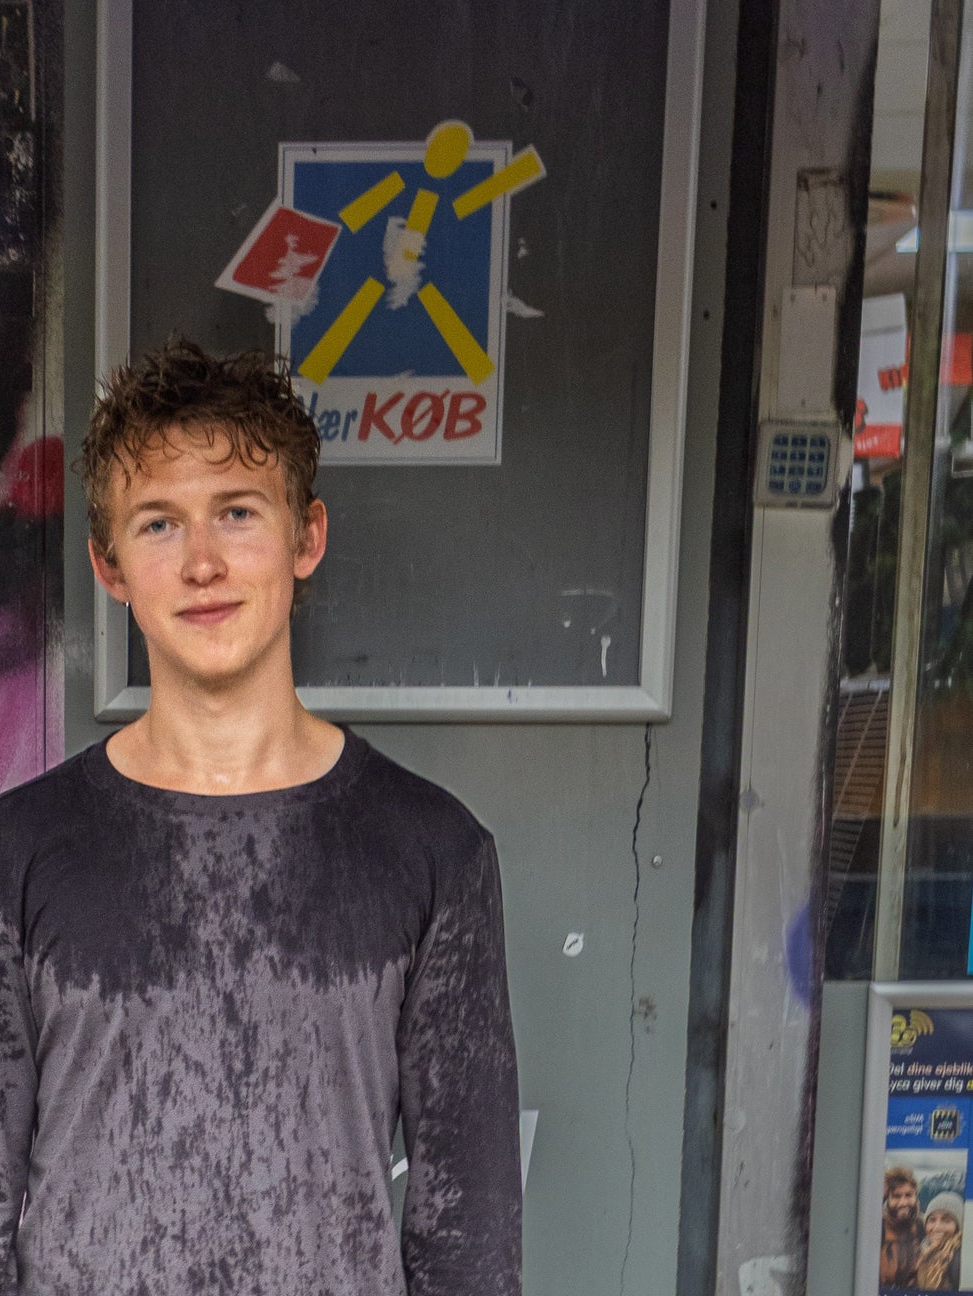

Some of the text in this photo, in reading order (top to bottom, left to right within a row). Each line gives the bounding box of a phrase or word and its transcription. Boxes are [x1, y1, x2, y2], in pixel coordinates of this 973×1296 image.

[889, 1079, 911, 1093] yca
[913, 1077, 942, 1093] giver
[944, 1077, 964, 1094] dig
